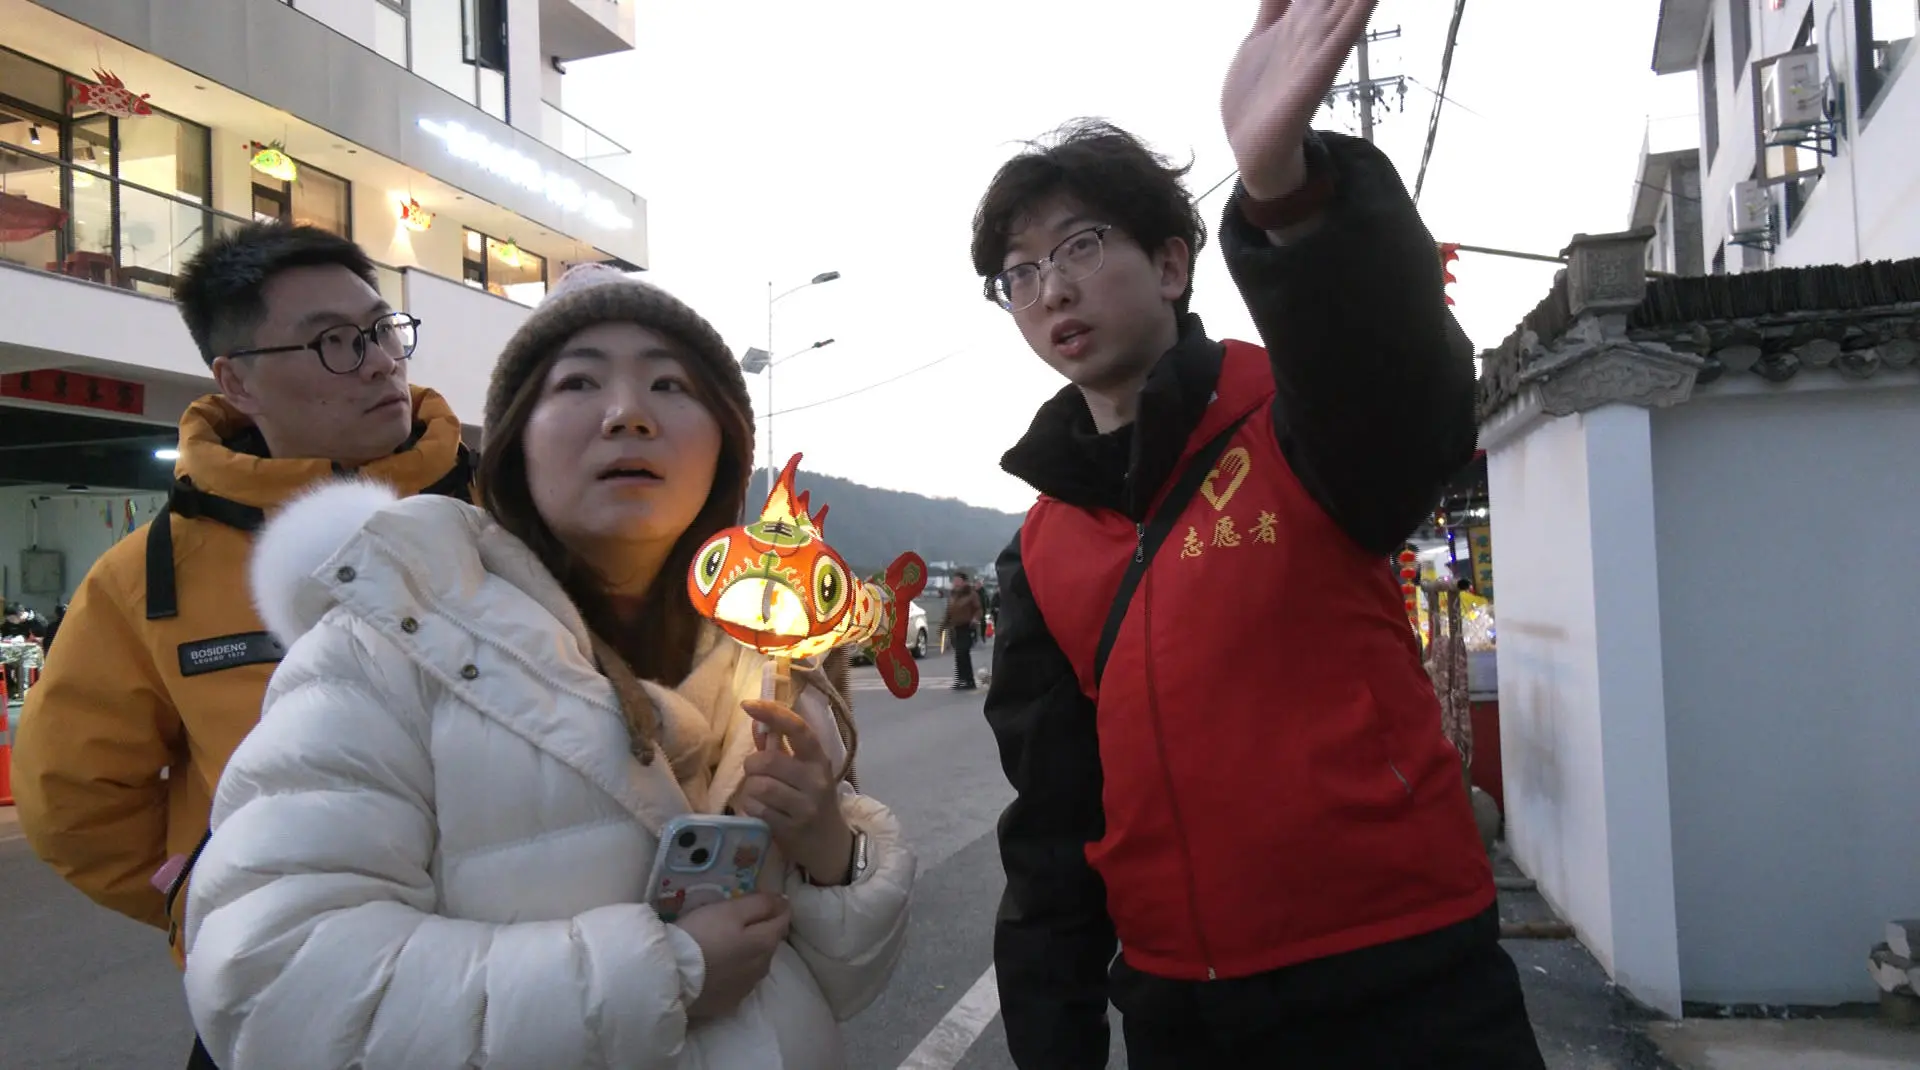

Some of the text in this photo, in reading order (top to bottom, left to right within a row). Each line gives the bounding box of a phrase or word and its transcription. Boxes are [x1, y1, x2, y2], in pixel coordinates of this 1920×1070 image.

[1181, 510, 1278, 560] 志愿者
[190, 642, 247, 660] BOSIDENG
